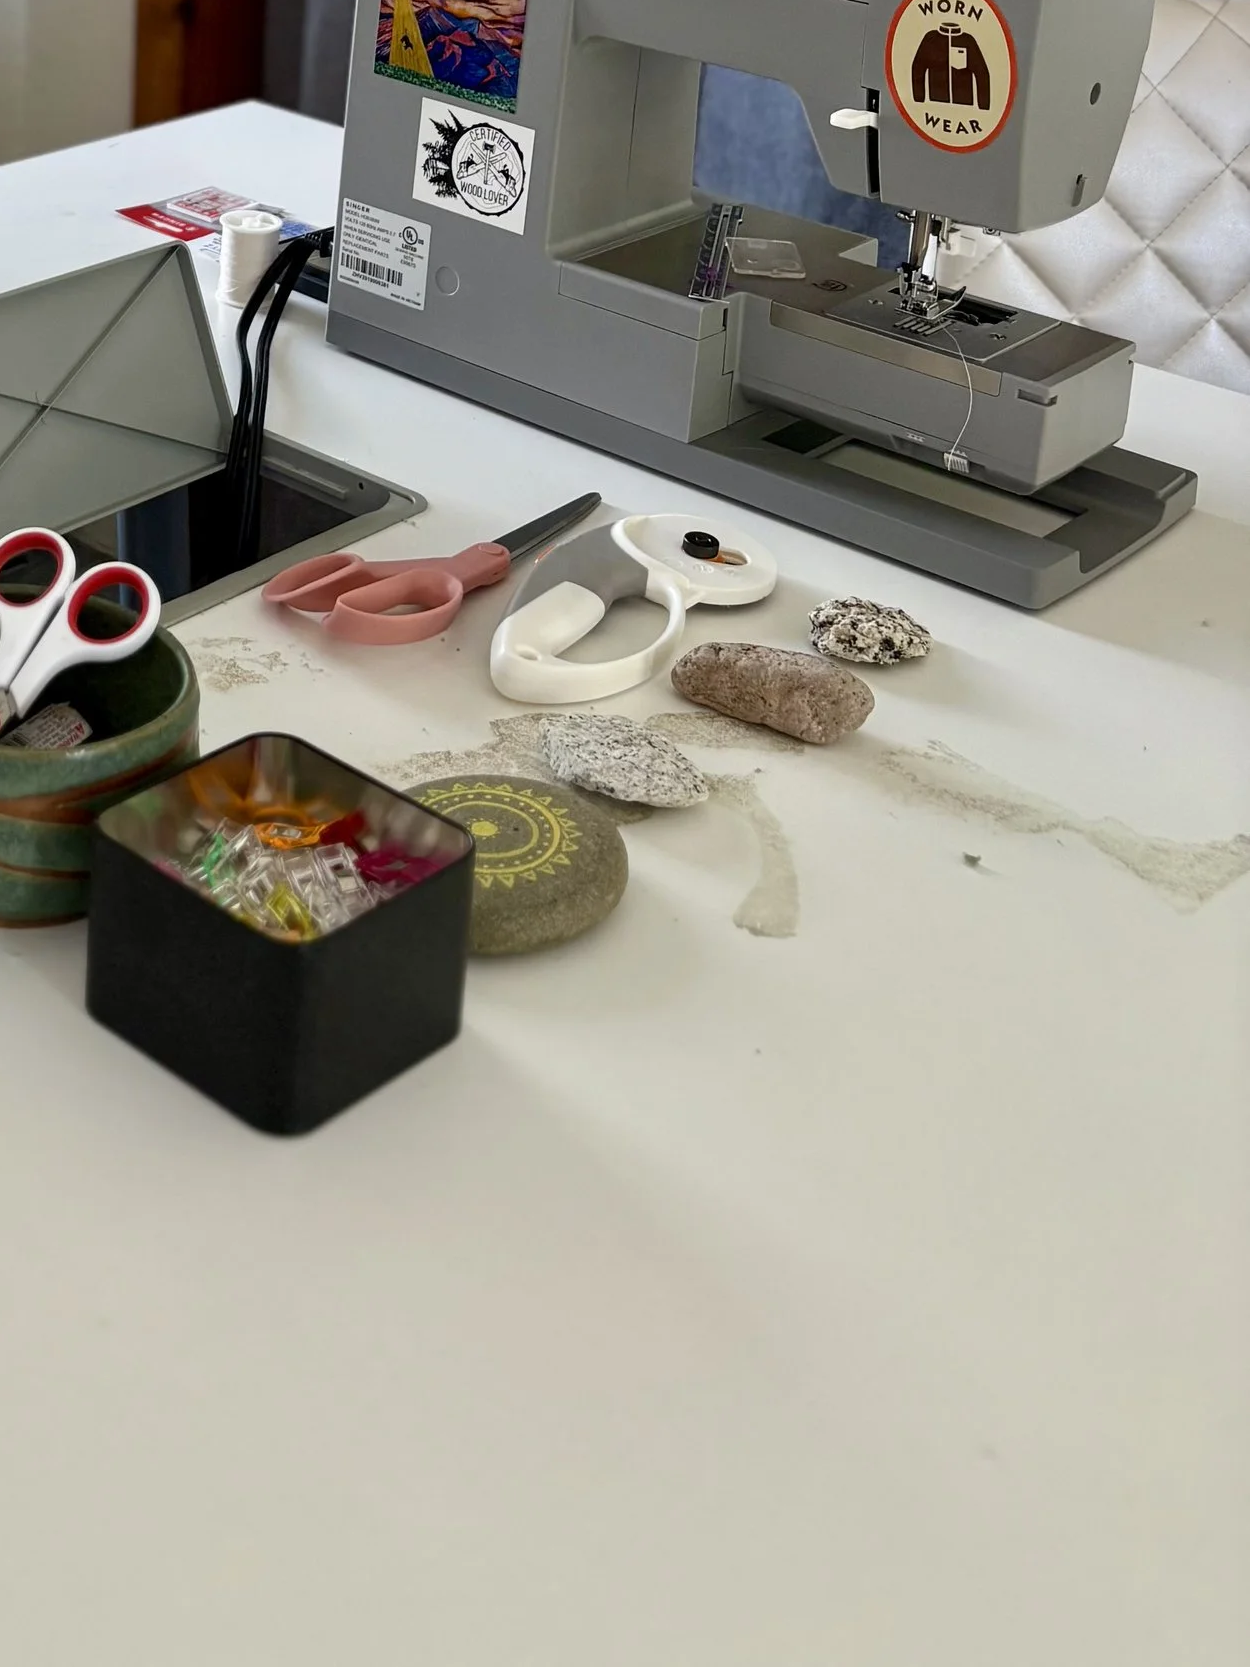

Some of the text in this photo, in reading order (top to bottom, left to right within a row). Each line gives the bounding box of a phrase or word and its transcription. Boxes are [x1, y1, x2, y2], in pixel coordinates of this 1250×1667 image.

[924, 112, 983, 135] WEAR
[469, 127, 511, 151] CERTIFIED
[461, 181, 509, 206] WOOD LOVER
[346, 201, 370, 213] SINGER
